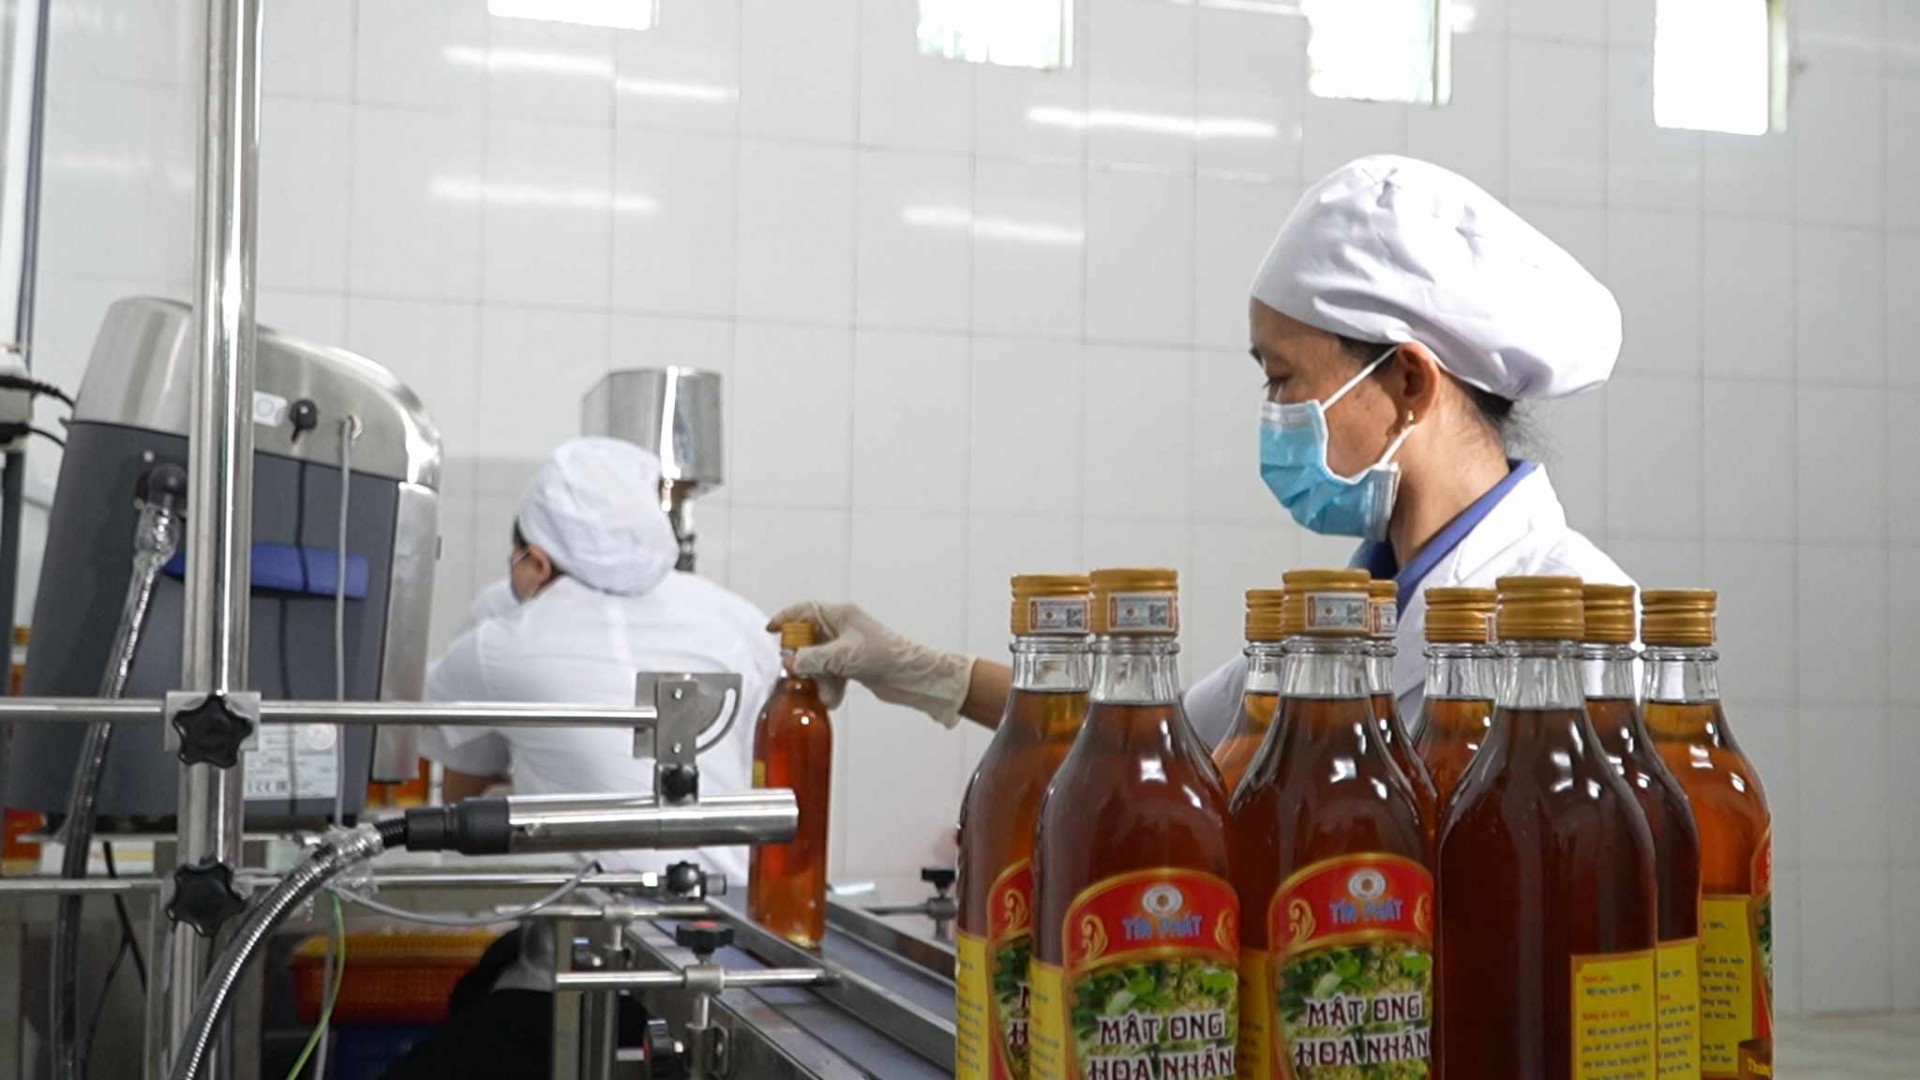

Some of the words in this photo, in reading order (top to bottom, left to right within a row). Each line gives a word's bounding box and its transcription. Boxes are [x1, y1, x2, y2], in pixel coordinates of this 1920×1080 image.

[1307, 996, 1365, 1031] MẬT
[1373, 995, 1421, 1022] ONG
[1100, 1012, 1160, 1049] MẬT
[1169, 1012, 1224, 1041] ONG
[1296, 1040, 1356, 1066] HOA
[1088, 1058, 1152, 1080] HOA
